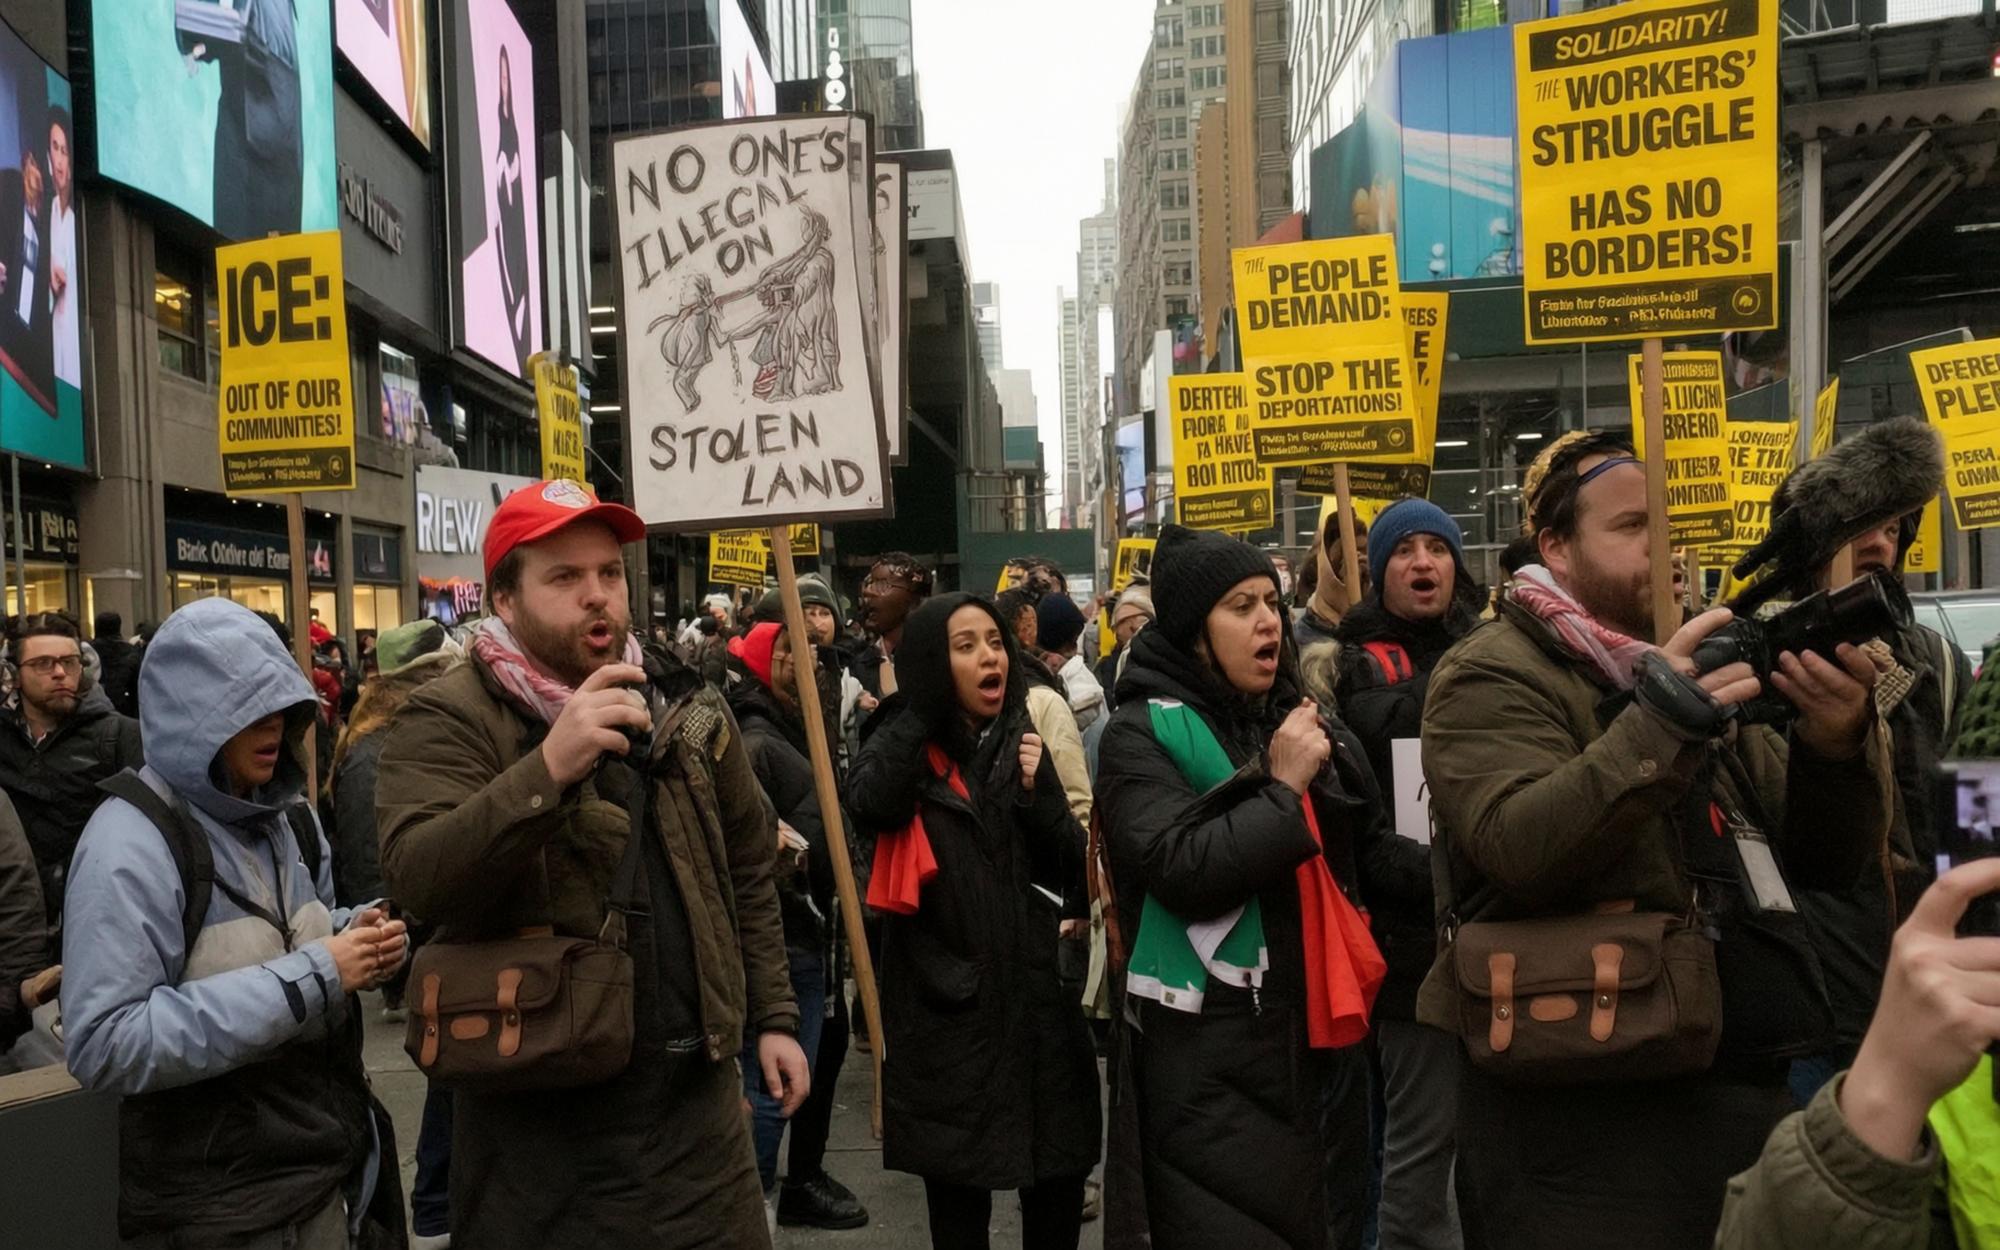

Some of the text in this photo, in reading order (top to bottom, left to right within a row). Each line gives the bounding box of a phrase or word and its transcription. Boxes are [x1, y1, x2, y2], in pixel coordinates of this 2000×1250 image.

[1555, 8, 1728, 60] SOLIDARITY!
[1535, 49, 1756, 111] THE WORKERS'
[1532, 96, 1754, 167] STRUGGLE
[627, 125, 847, 216] NO ONE'S
[1570, 177, 1722, 231] HAS NO
[626, 174, 808, 291] ILLEGAL
[716, 224, 774, 279] ON
[1545, 223, 1753, 280] BORDERS!
[1268, 254, 1388, 295] PEOPLE
[226, 257, 332, 348] ICE:
[1248, 290, 1390, 331] DEMAND:
[226, 378, 341, 414] OUT OF OUR
[1256, 361, 1335, 397] STOP
[1343, 358, 1403, 391] THE
[226, 414, 342, 441] COMMUNITIES!
[1259, 392, 1403, 420] DEPORTATIONS!
[649, 410, 820, 474] STOLEN
[741, 458, 864, 508] LAND
